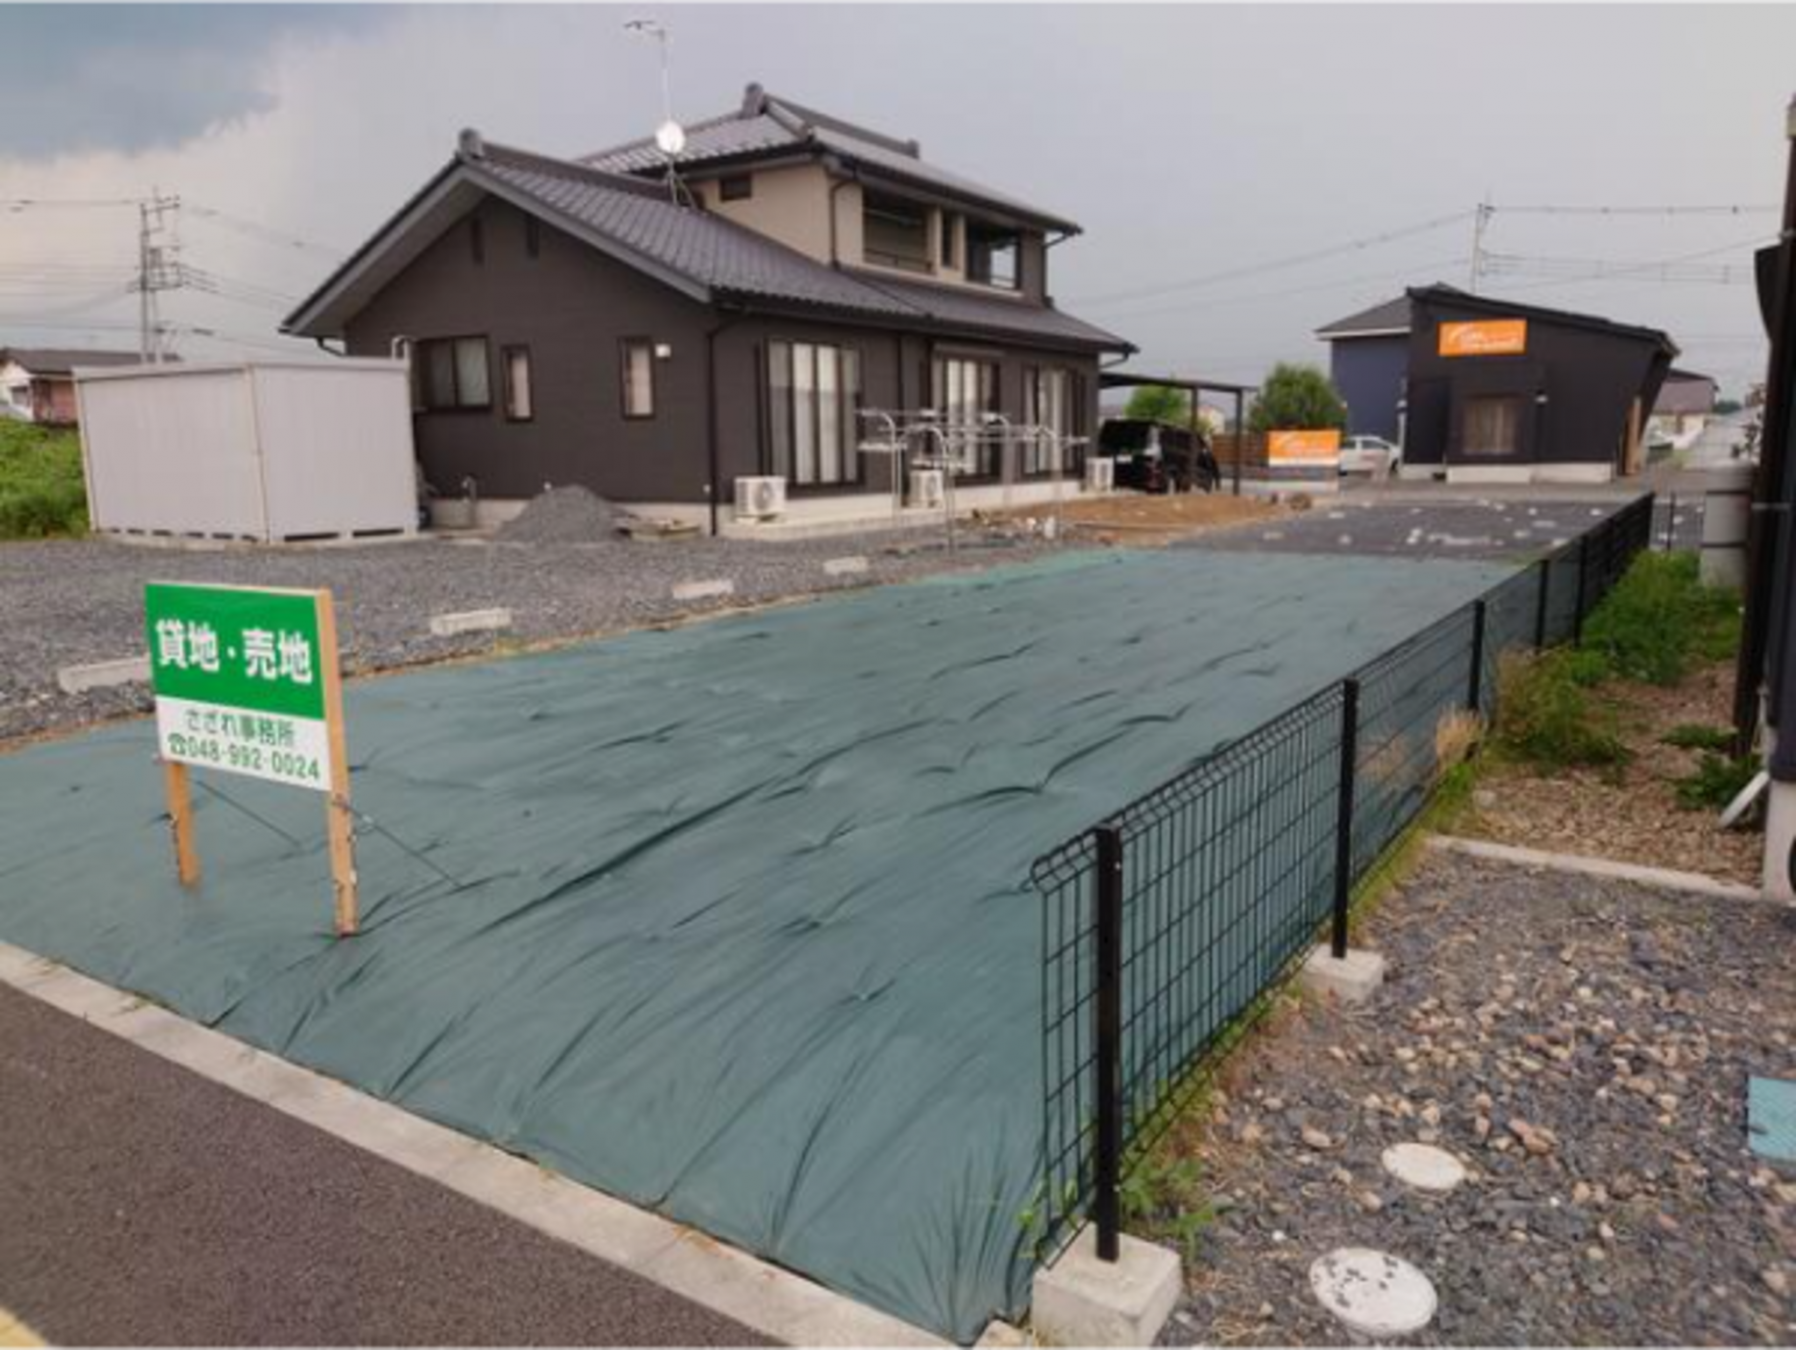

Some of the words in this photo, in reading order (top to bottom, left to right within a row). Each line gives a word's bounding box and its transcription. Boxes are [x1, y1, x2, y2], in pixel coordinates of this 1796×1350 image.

[156, 618, 313, 684] 貸地・売地
